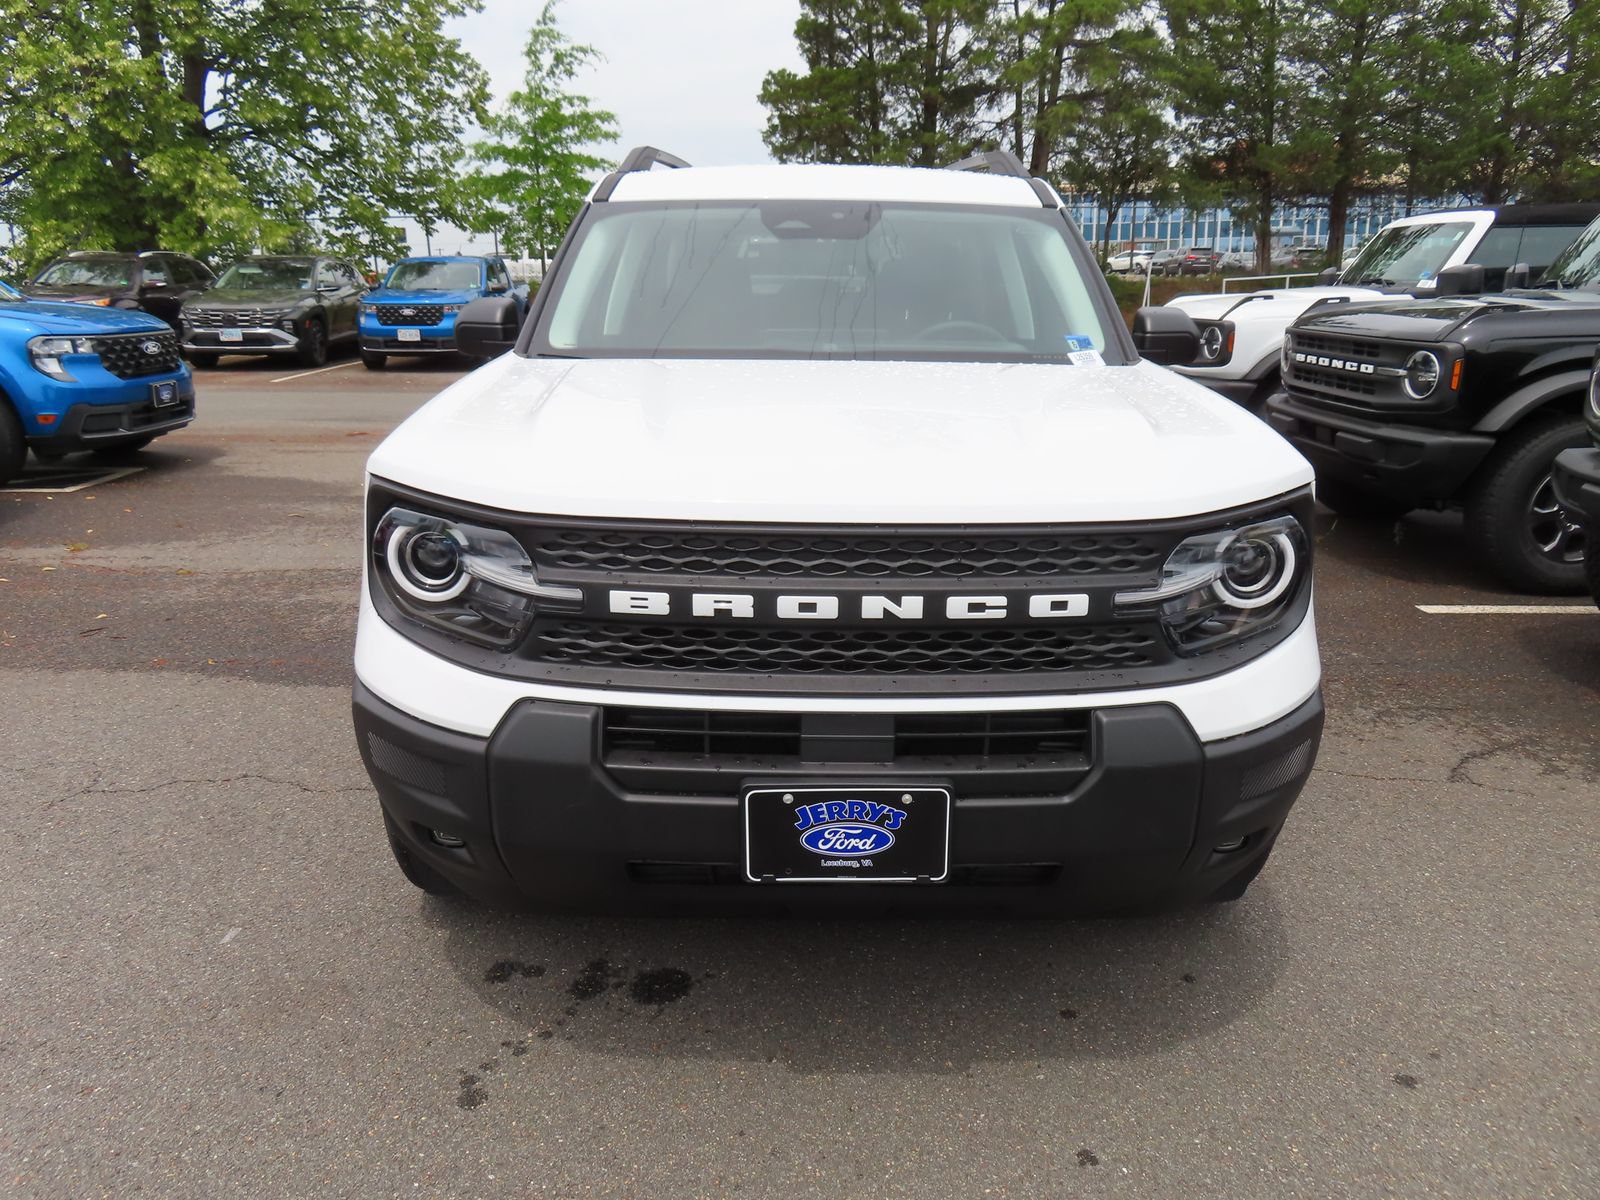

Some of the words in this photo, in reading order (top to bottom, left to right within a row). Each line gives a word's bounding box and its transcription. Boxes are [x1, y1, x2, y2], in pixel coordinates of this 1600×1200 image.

[1295, 353, 1374, 374] BRONCO
[609, 590, 1090, 619] BRONCO
[795, 800, 907, 830] JERRY'S
[818, 828, 878, 850] Ford
[861, 859, 873, 867] VA
